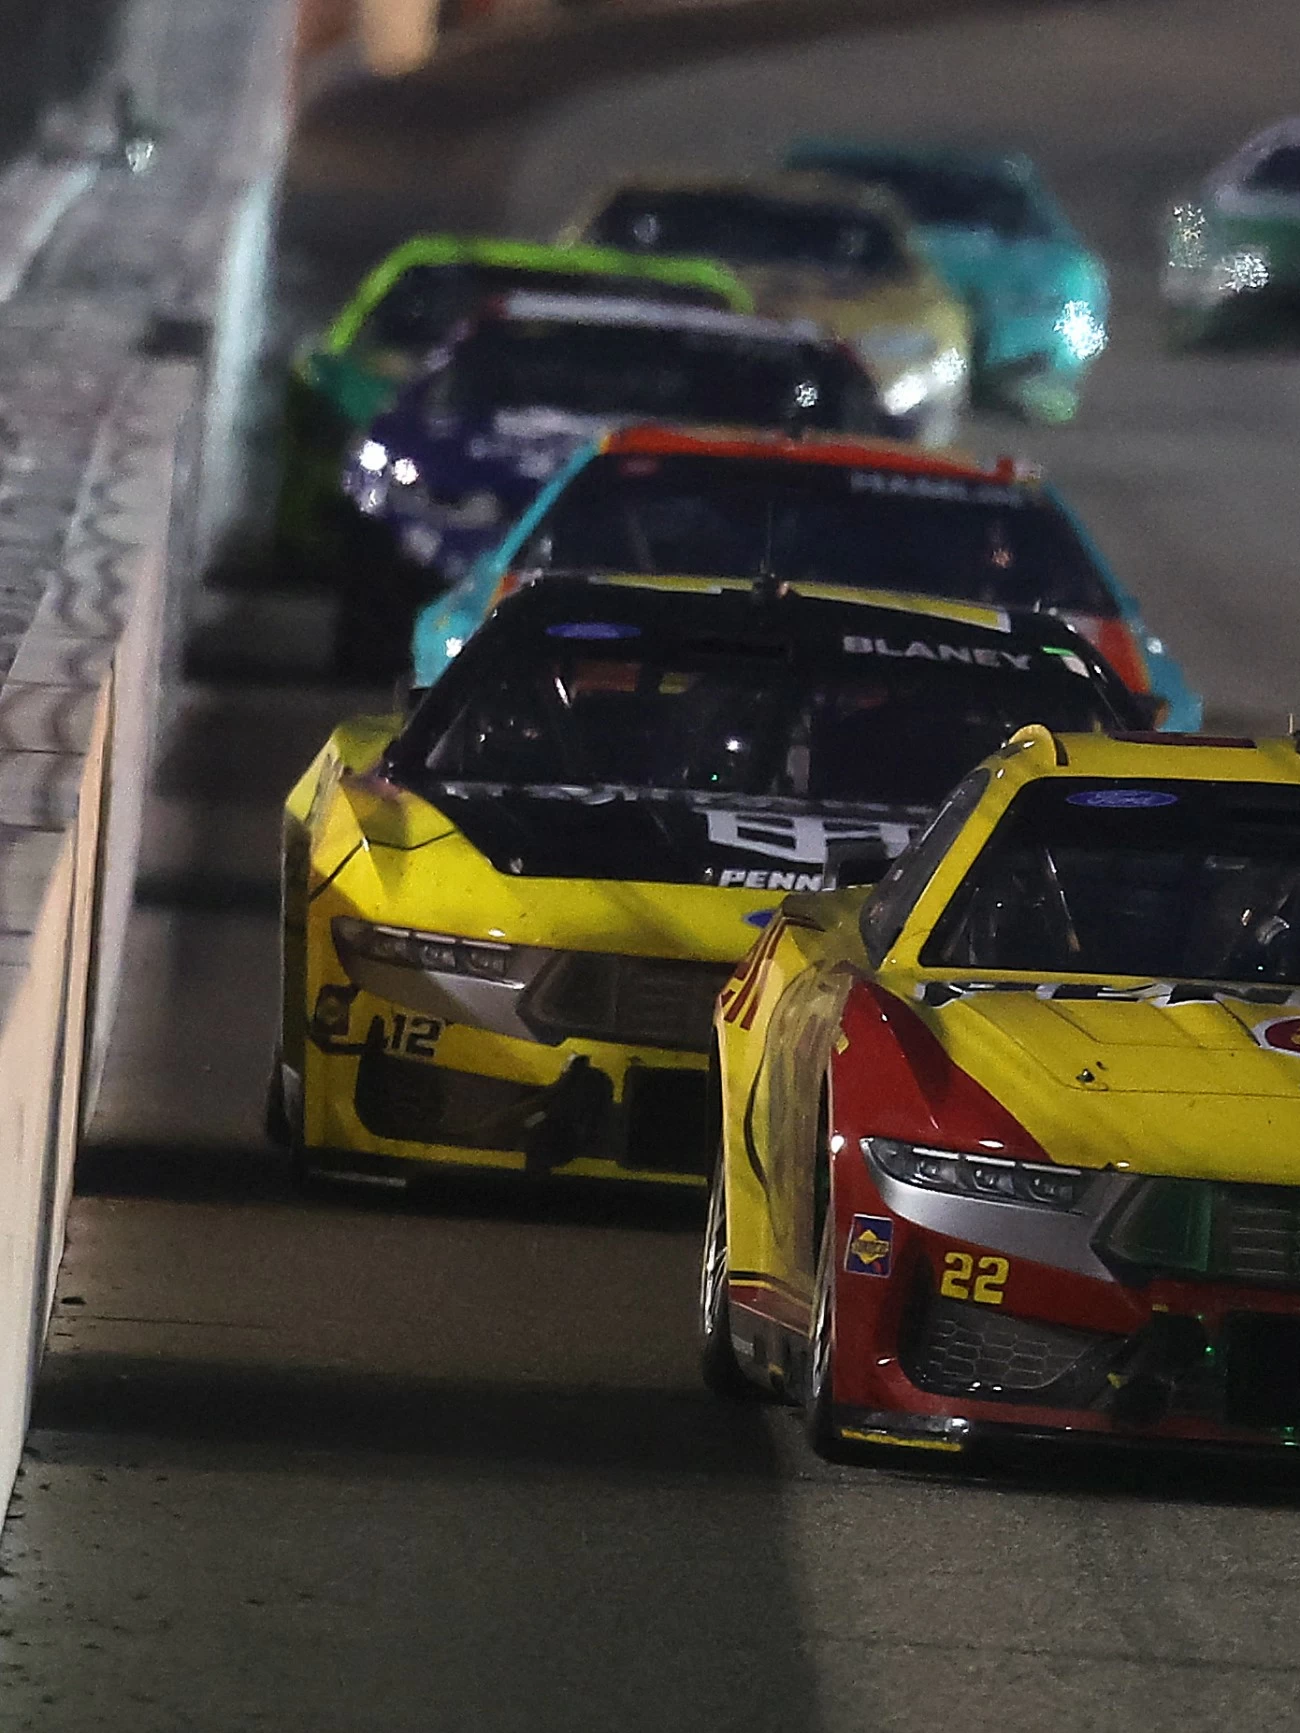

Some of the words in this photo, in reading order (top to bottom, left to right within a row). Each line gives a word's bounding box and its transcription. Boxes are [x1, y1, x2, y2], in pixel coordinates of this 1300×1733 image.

[843, 635, 1032, 670] BLANEY
[391, 1013, 441, 1057] 12
[940, 1251, 1010, 1305] 22
